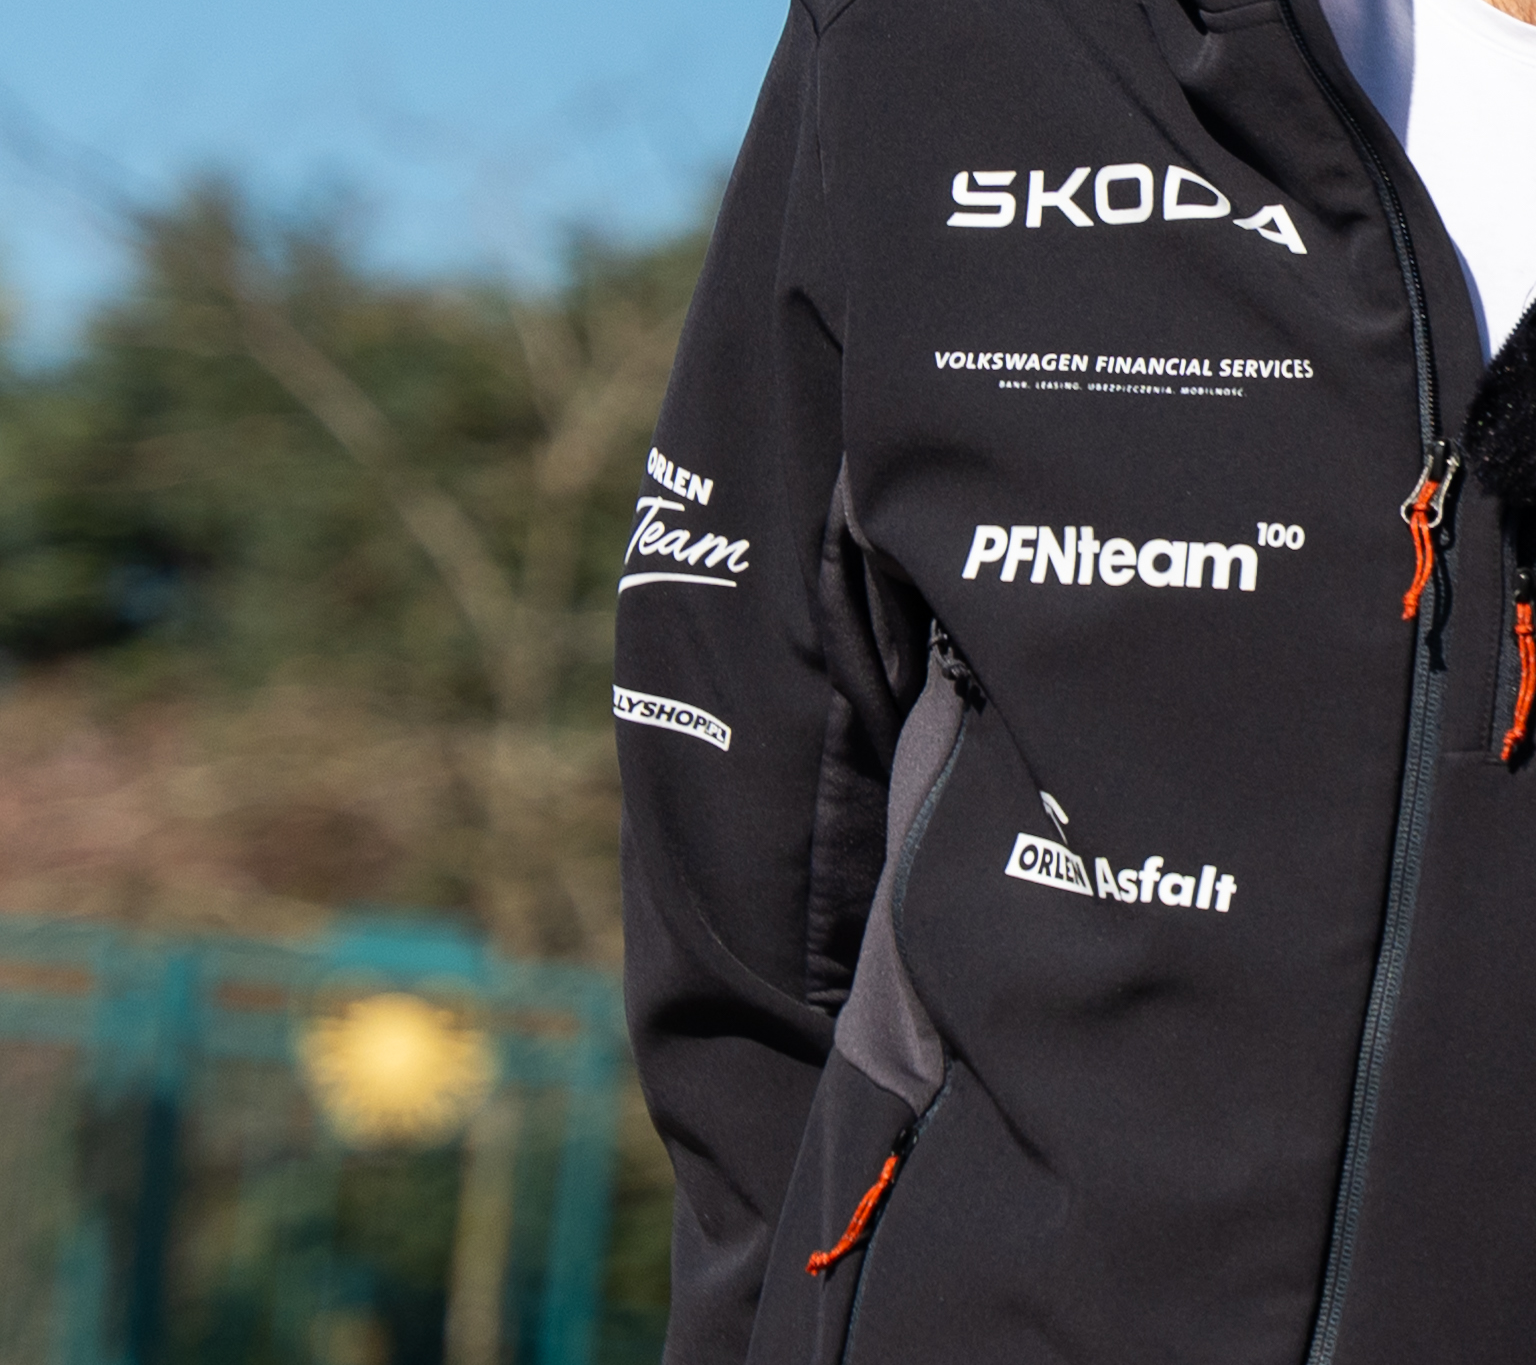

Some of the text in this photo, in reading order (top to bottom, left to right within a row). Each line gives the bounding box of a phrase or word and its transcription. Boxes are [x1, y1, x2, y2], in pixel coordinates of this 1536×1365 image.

[934, 351, 1314, 379] VOLKSWAGEN FINANCIAL SERVICES
[646, 447, 714, 506] ORLEN
[624, 495, 750, 574] Team
[1019, 844, 1238, 913] ORLEN Asfalt
